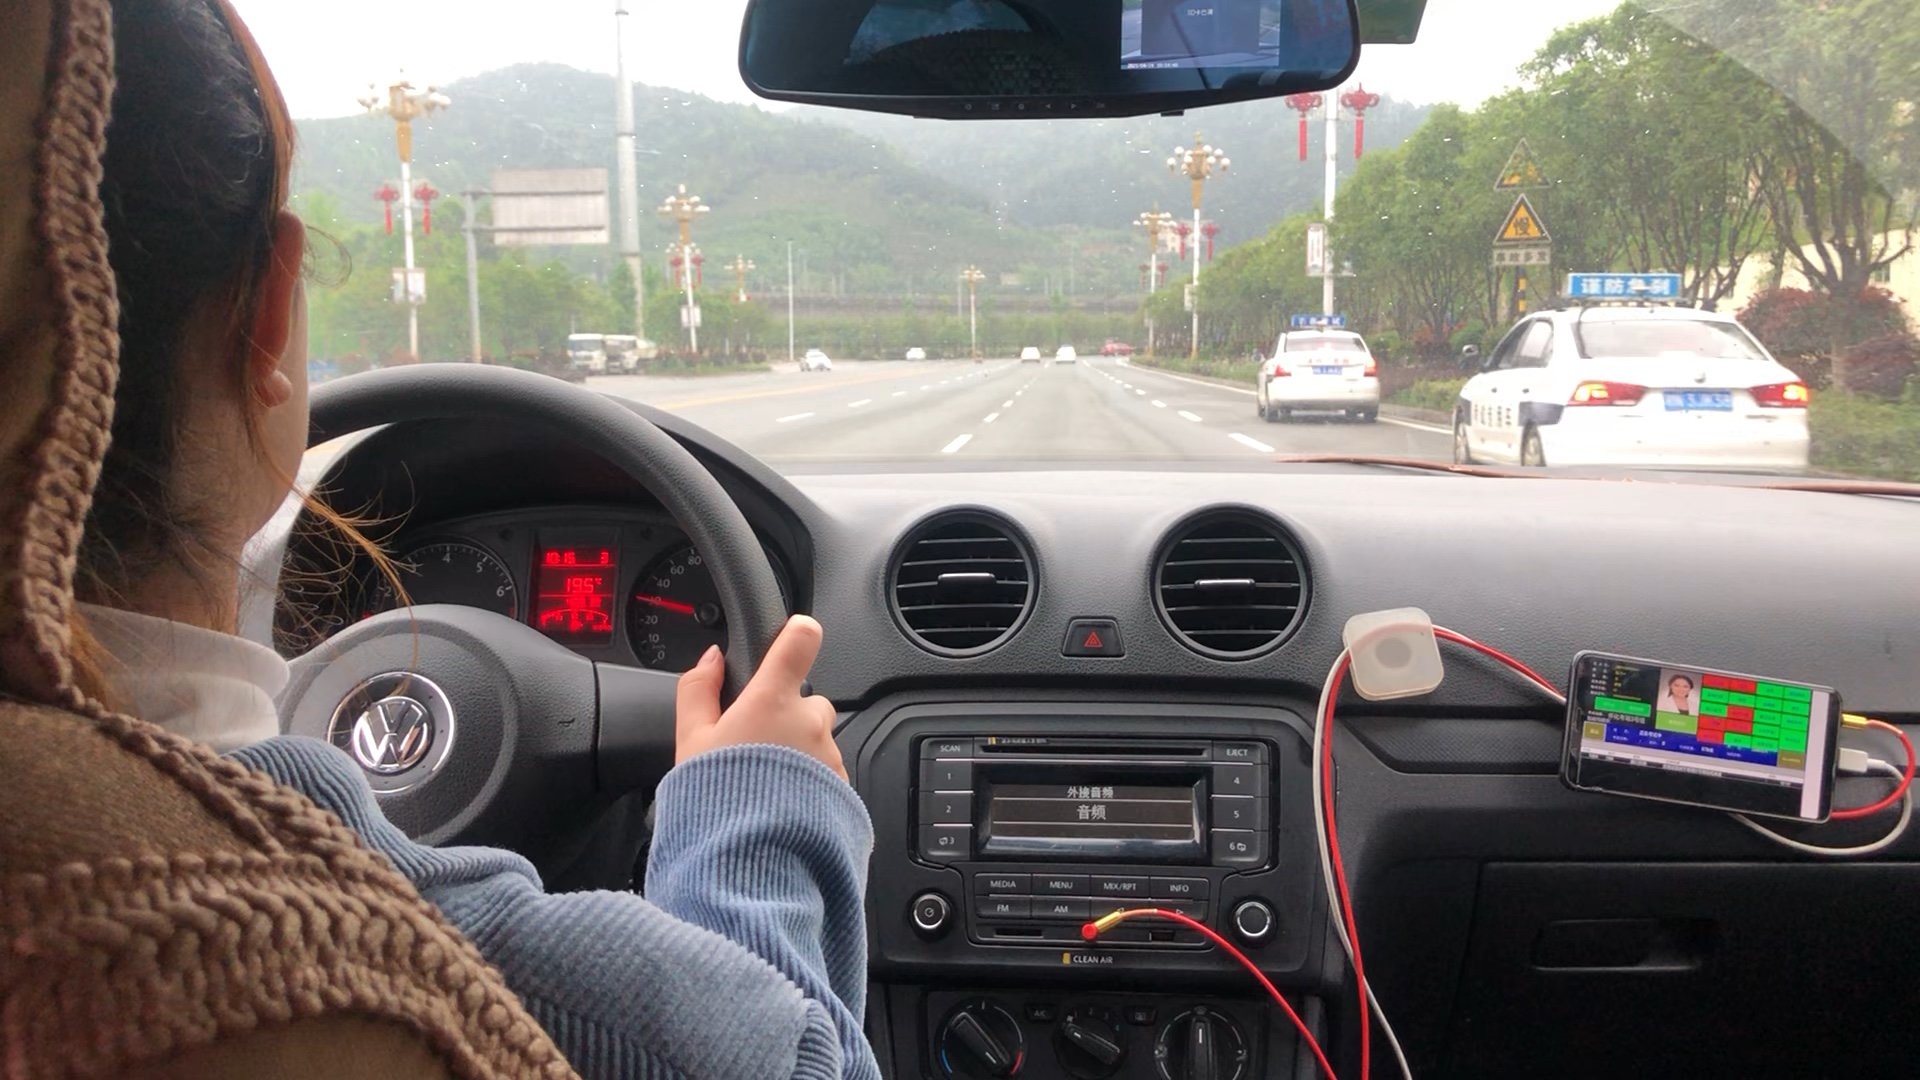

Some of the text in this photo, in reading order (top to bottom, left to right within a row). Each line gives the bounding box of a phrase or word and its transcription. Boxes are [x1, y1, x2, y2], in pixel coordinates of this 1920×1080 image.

[1513, 217, 1531, 236] 慢
[443, 551, 451, 564] 4
[688, 555, 702, 566] 80
[476, 561, 484, 573] 5
[670, 565, 685, 575] 60
[656, 578, 671, 588] 40
[496, 586, 506, 597] 6
[648, 633, 660, 643] 10
[657, 650, 666, 660] 0
[940, 744, 961, 753] SCAN
[1226, 748, 1249, 757] EJECT
[947, 772, 952, 780] 1
[1233, 776, 1240, 785] 4
[1067, 785, 1114, 799] 外接音频
[945, 805, 952, 814] 2
[1077, 804, 1106, 820] 音频
[1233, 810, 1240, 819] 5
[949, 836, 955, 845] 3
[1229, 842, 1236, 851] 6
[990, 880, 1016, 889] MEDIA
[1050, 881, 1073, 890] MENU
[1103, 882, 1137, 892] MIX/RPT
[1169, 884, 1189, 893] INFO
[997, 904, 1009, 913] FM
[1054, 905, 1069, 914] AM
[1073, 954, 1114, 964] CLEAN AIR
